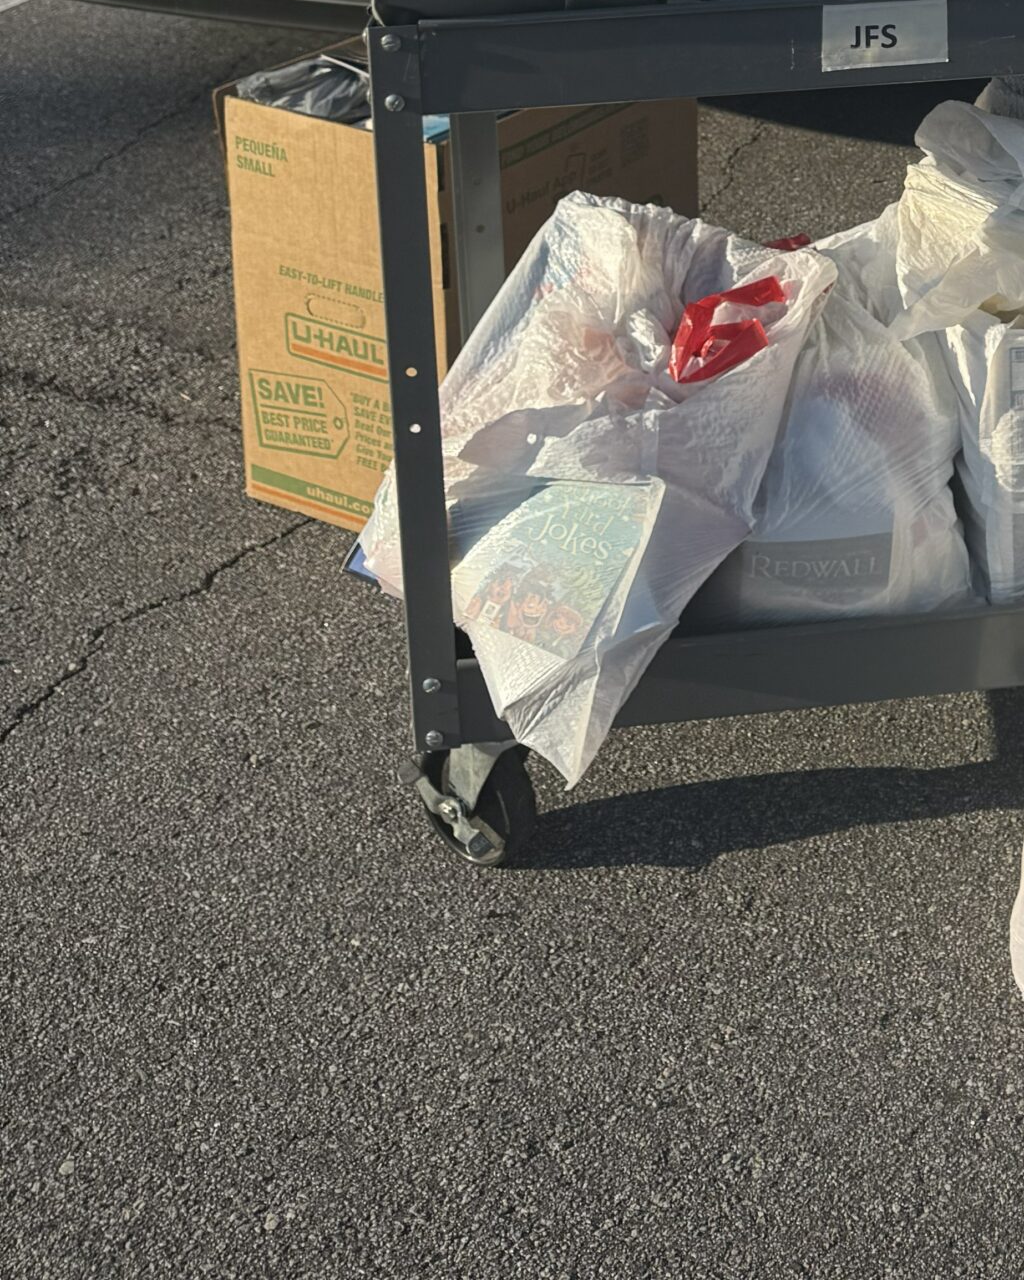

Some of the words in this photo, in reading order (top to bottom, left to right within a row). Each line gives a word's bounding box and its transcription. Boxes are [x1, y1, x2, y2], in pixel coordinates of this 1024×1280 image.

[850, 23, 898, 49] JFS
[234, 135, 288, 162] PEQUEÑA
[236, 155, 275, 177] SMALL
[278, 264, 343, 293] EASY-TO-LIFT
[291, 320, 385, 366] U-HAUL
[257, 378, 325, 409] SAVE!
[261, 410, 291, 428] BEST
[292, 415, 329, 434] PRICE
[306, 484, 371, 513] uhaul.co
[528, 513, 613, 561] Jokes
